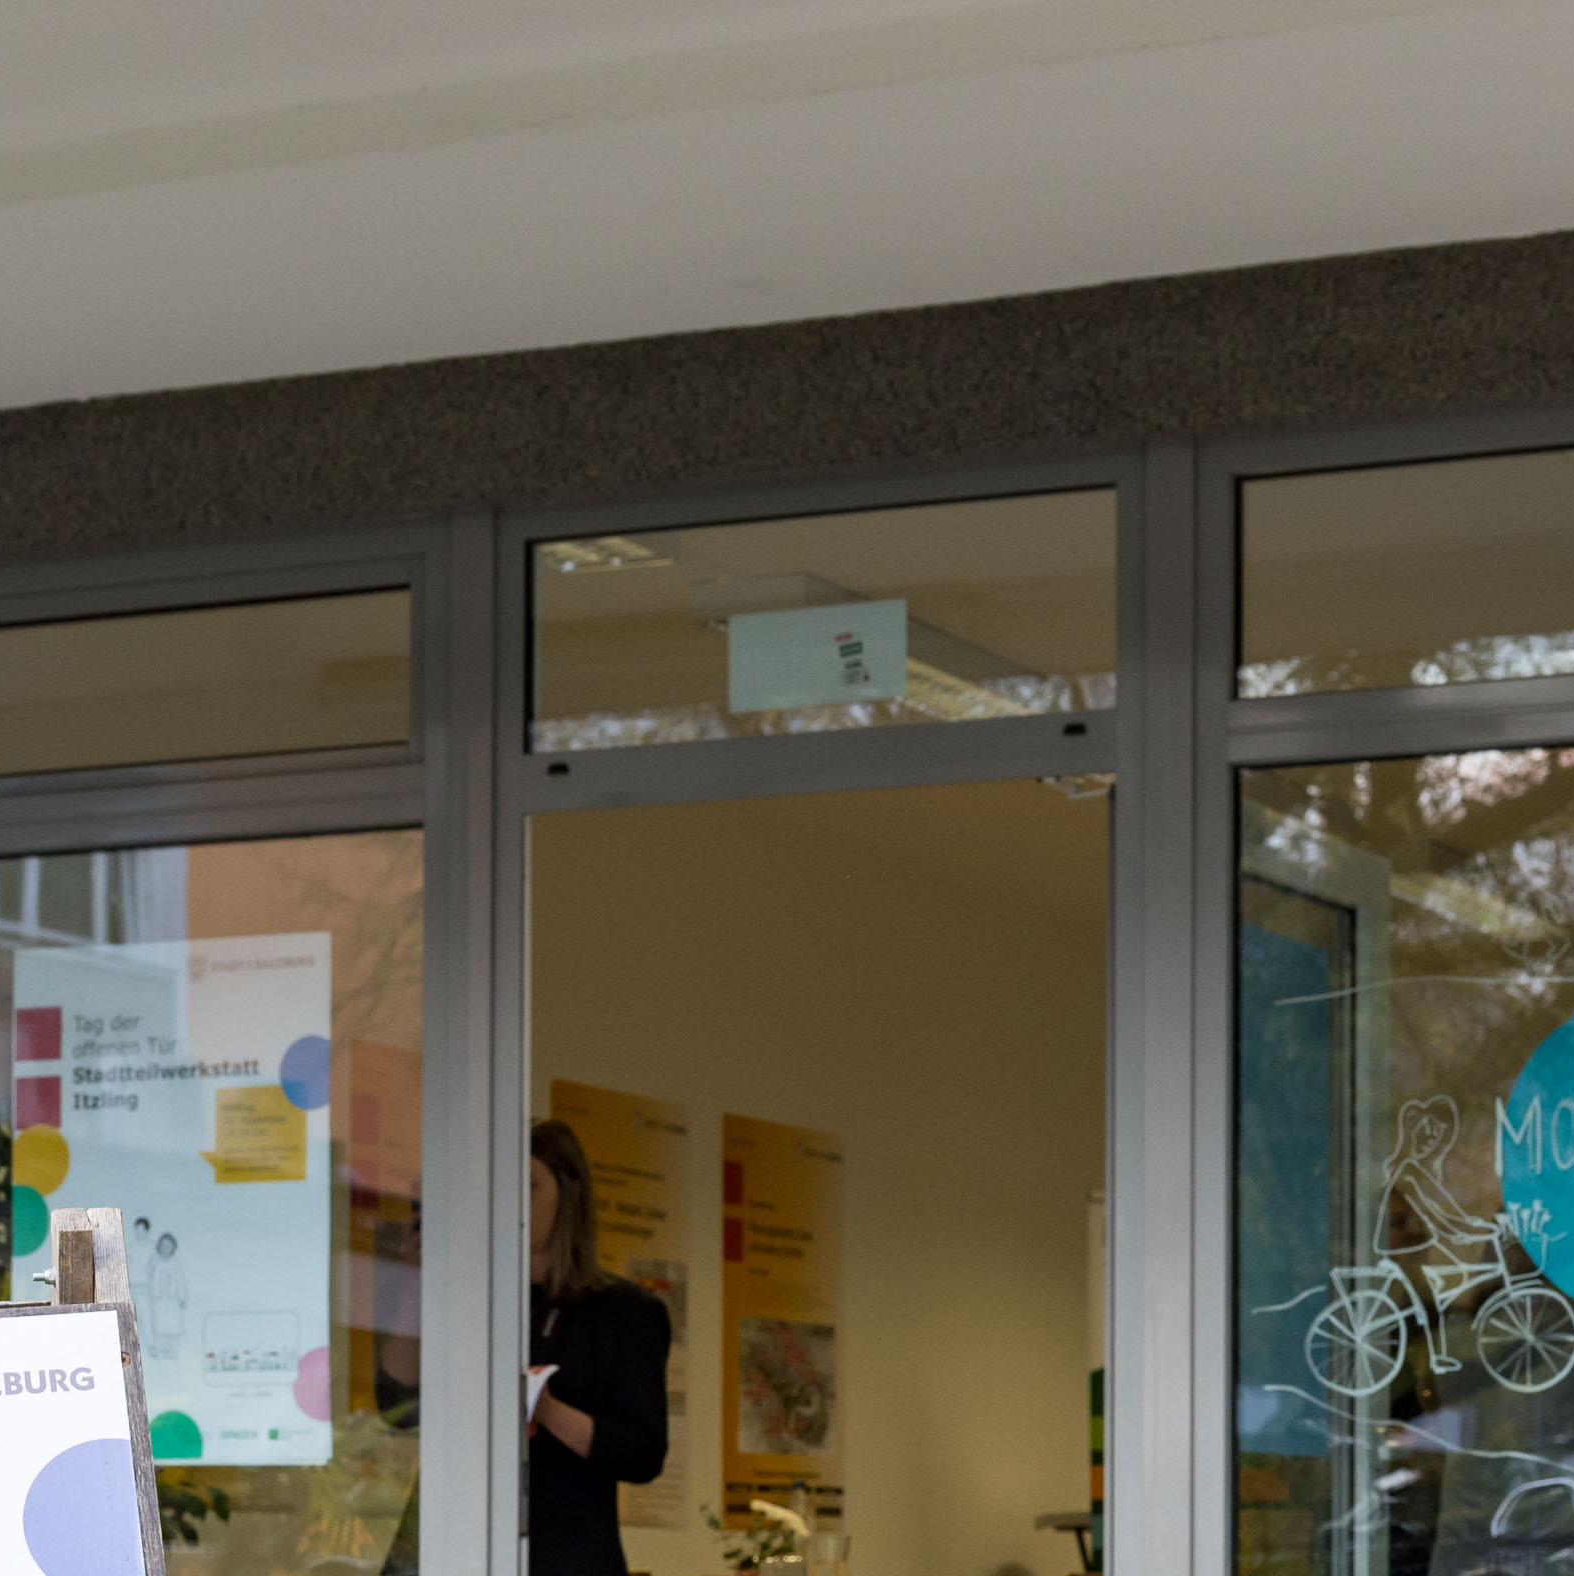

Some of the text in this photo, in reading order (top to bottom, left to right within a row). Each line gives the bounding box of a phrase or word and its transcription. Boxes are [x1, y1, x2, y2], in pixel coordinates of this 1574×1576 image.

[74, 1014, 140, 1037] Tag der
[73, 1038, 141, 1058] offenen
[73, 1060, 259, 1084] Stadtteilwerkstatt
[73, 1092, 139, 1112] Itzling
